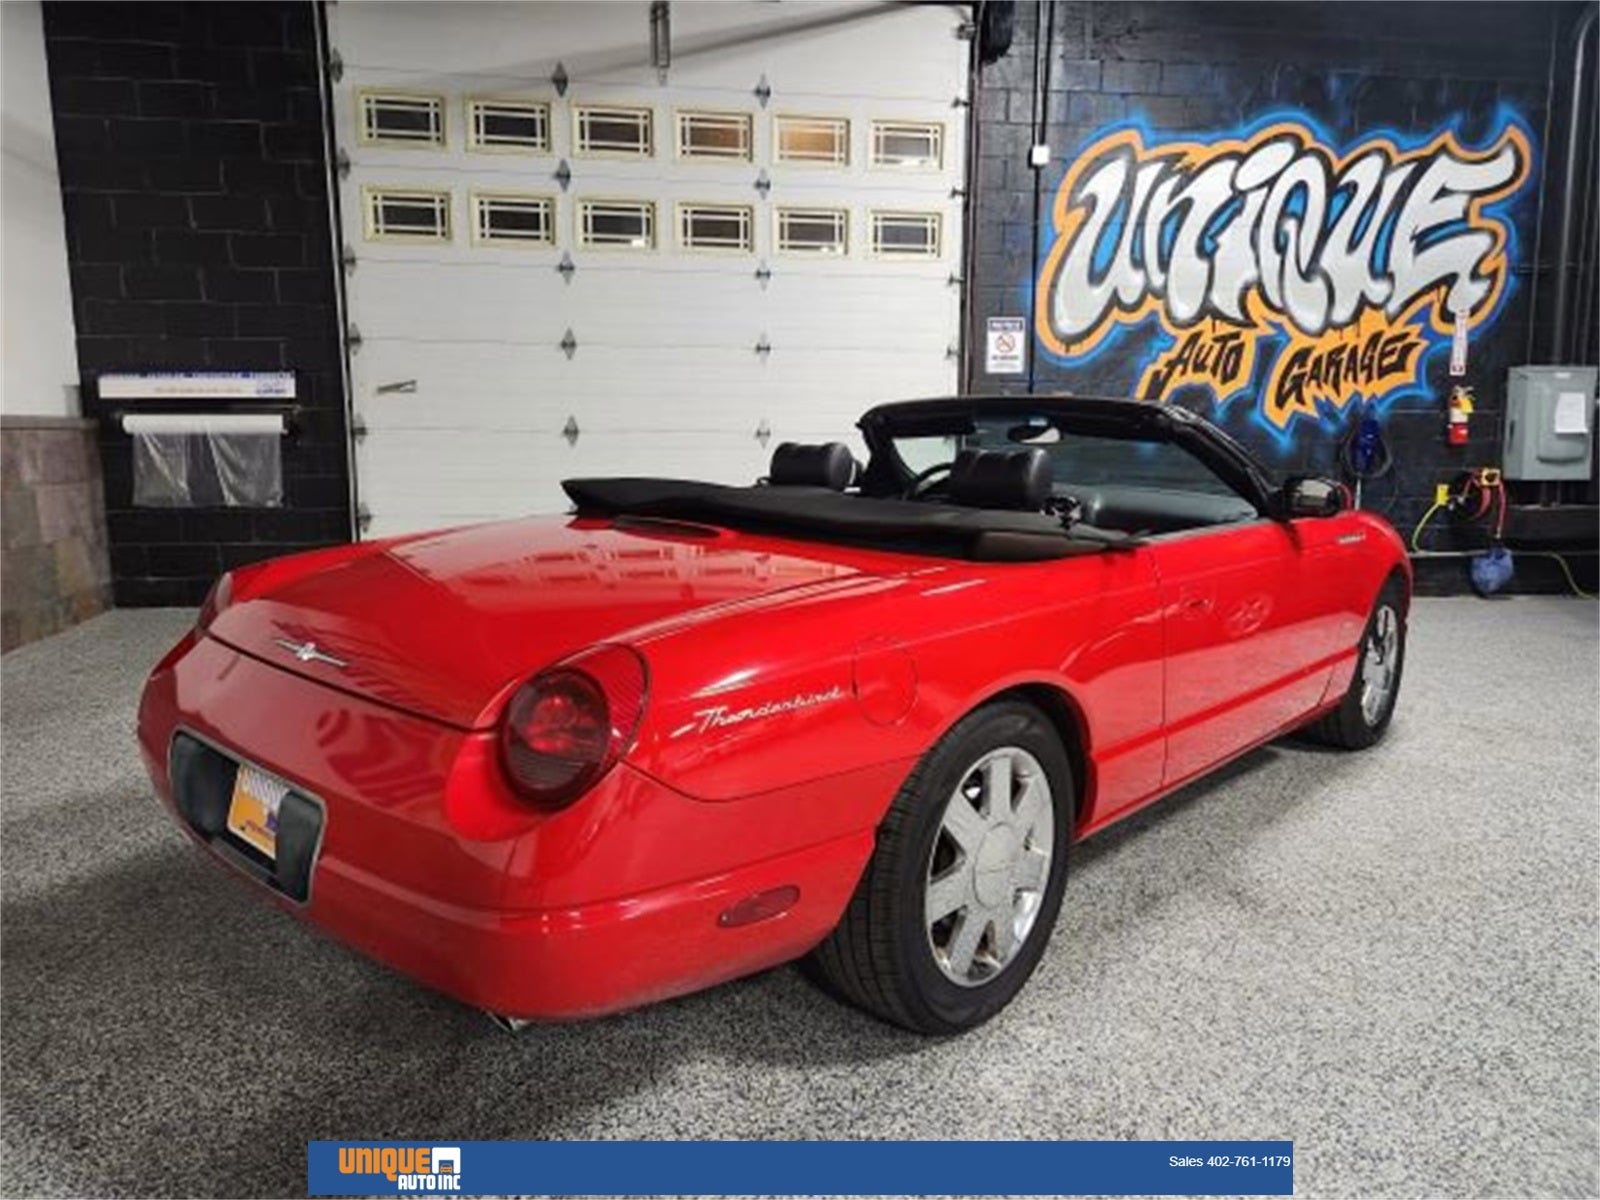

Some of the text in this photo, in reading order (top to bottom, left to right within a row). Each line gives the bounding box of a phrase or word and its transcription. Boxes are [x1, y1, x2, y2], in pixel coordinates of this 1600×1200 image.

[1050, 136, 1520, 336] UNIQUE
[1146, 329, 1246, 399] AUTO
[1275, 329, 1421, 410] GARAGE
